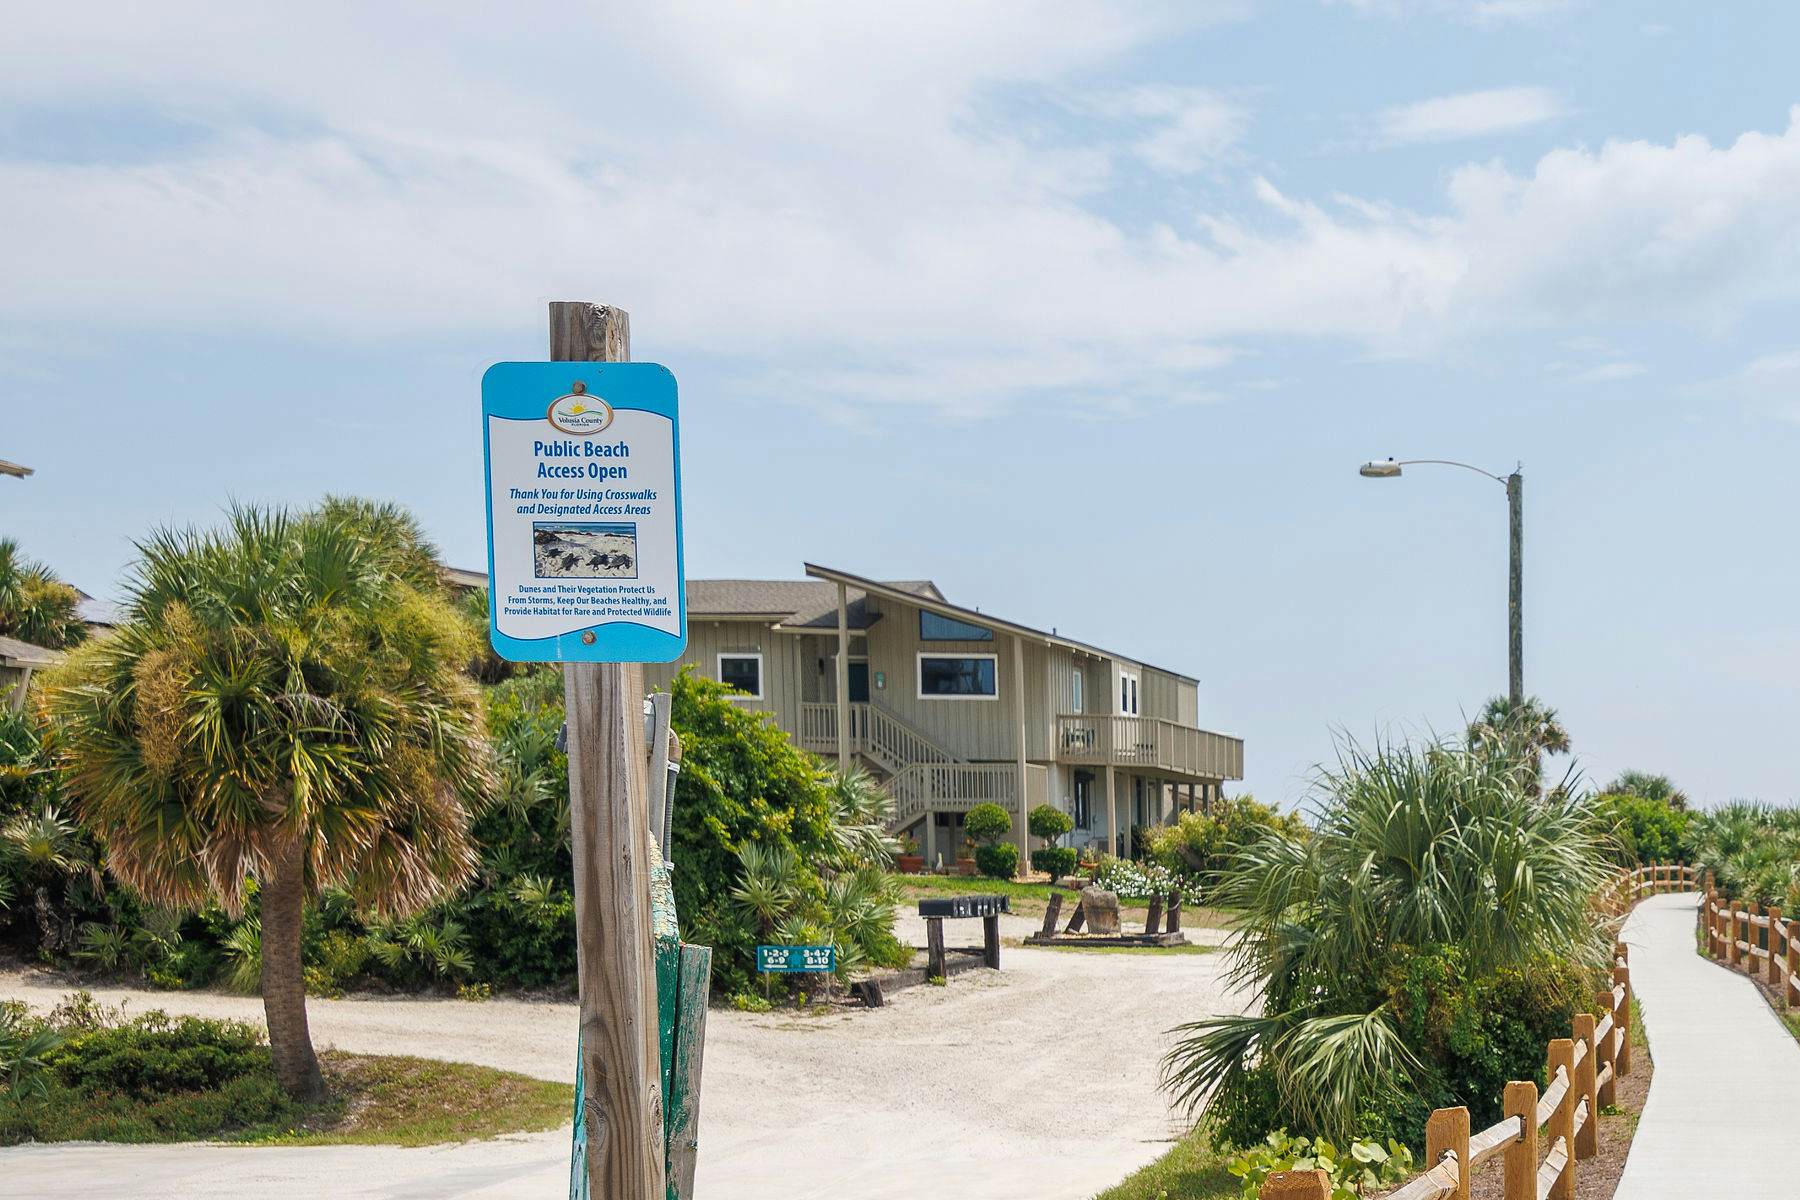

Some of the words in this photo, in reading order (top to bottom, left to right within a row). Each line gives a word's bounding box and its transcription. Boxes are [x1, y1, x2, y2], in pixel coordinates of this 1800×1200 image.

[534, 441, 580, 457] Public
[584, 441, 629, 457] Beach
[538, 462, 584, 478] Access
[588, 463, 627, 482] Open
[510, 489, 539, 499] Thank
[542, 489, 558, 499] You
[560, 489, 575, 499] for
[577, 489, 603, 502] Using
[606, 489, 657, 500] Crosswalks
[517, 504, 535, 514] and
[538, 504, 591, 517] Designated
[593, 504, 622, 514] Access
[624, 504, 650, 514] Areas
[519, 585, 541, 593] Dunes
[543, 585, 556, 593] and
[558, 585, 577, 593] Their
[577, 586, 617, 595] Vegetation
[619, 586, 645, 594] Protect
[647, 586, 655, 594] Us
[508, 596, 527, 604] From
[528, 596, 555, 605] Storms,
[557, 596, 574, 605] Keep
[621, 597, 651, 606] Healthy,
[653, 597, 667, 605] and
[504, 607, 531, 615] Provide
[533, 607, 560, 615] Habitat
[562, 608, 573, 616] for
[574, 608, 590, 616] Rare
[592, 608, 606, 616] and
[607, 608, 642, 616] Protected
[643, 608, 672, 616] Wildlife
